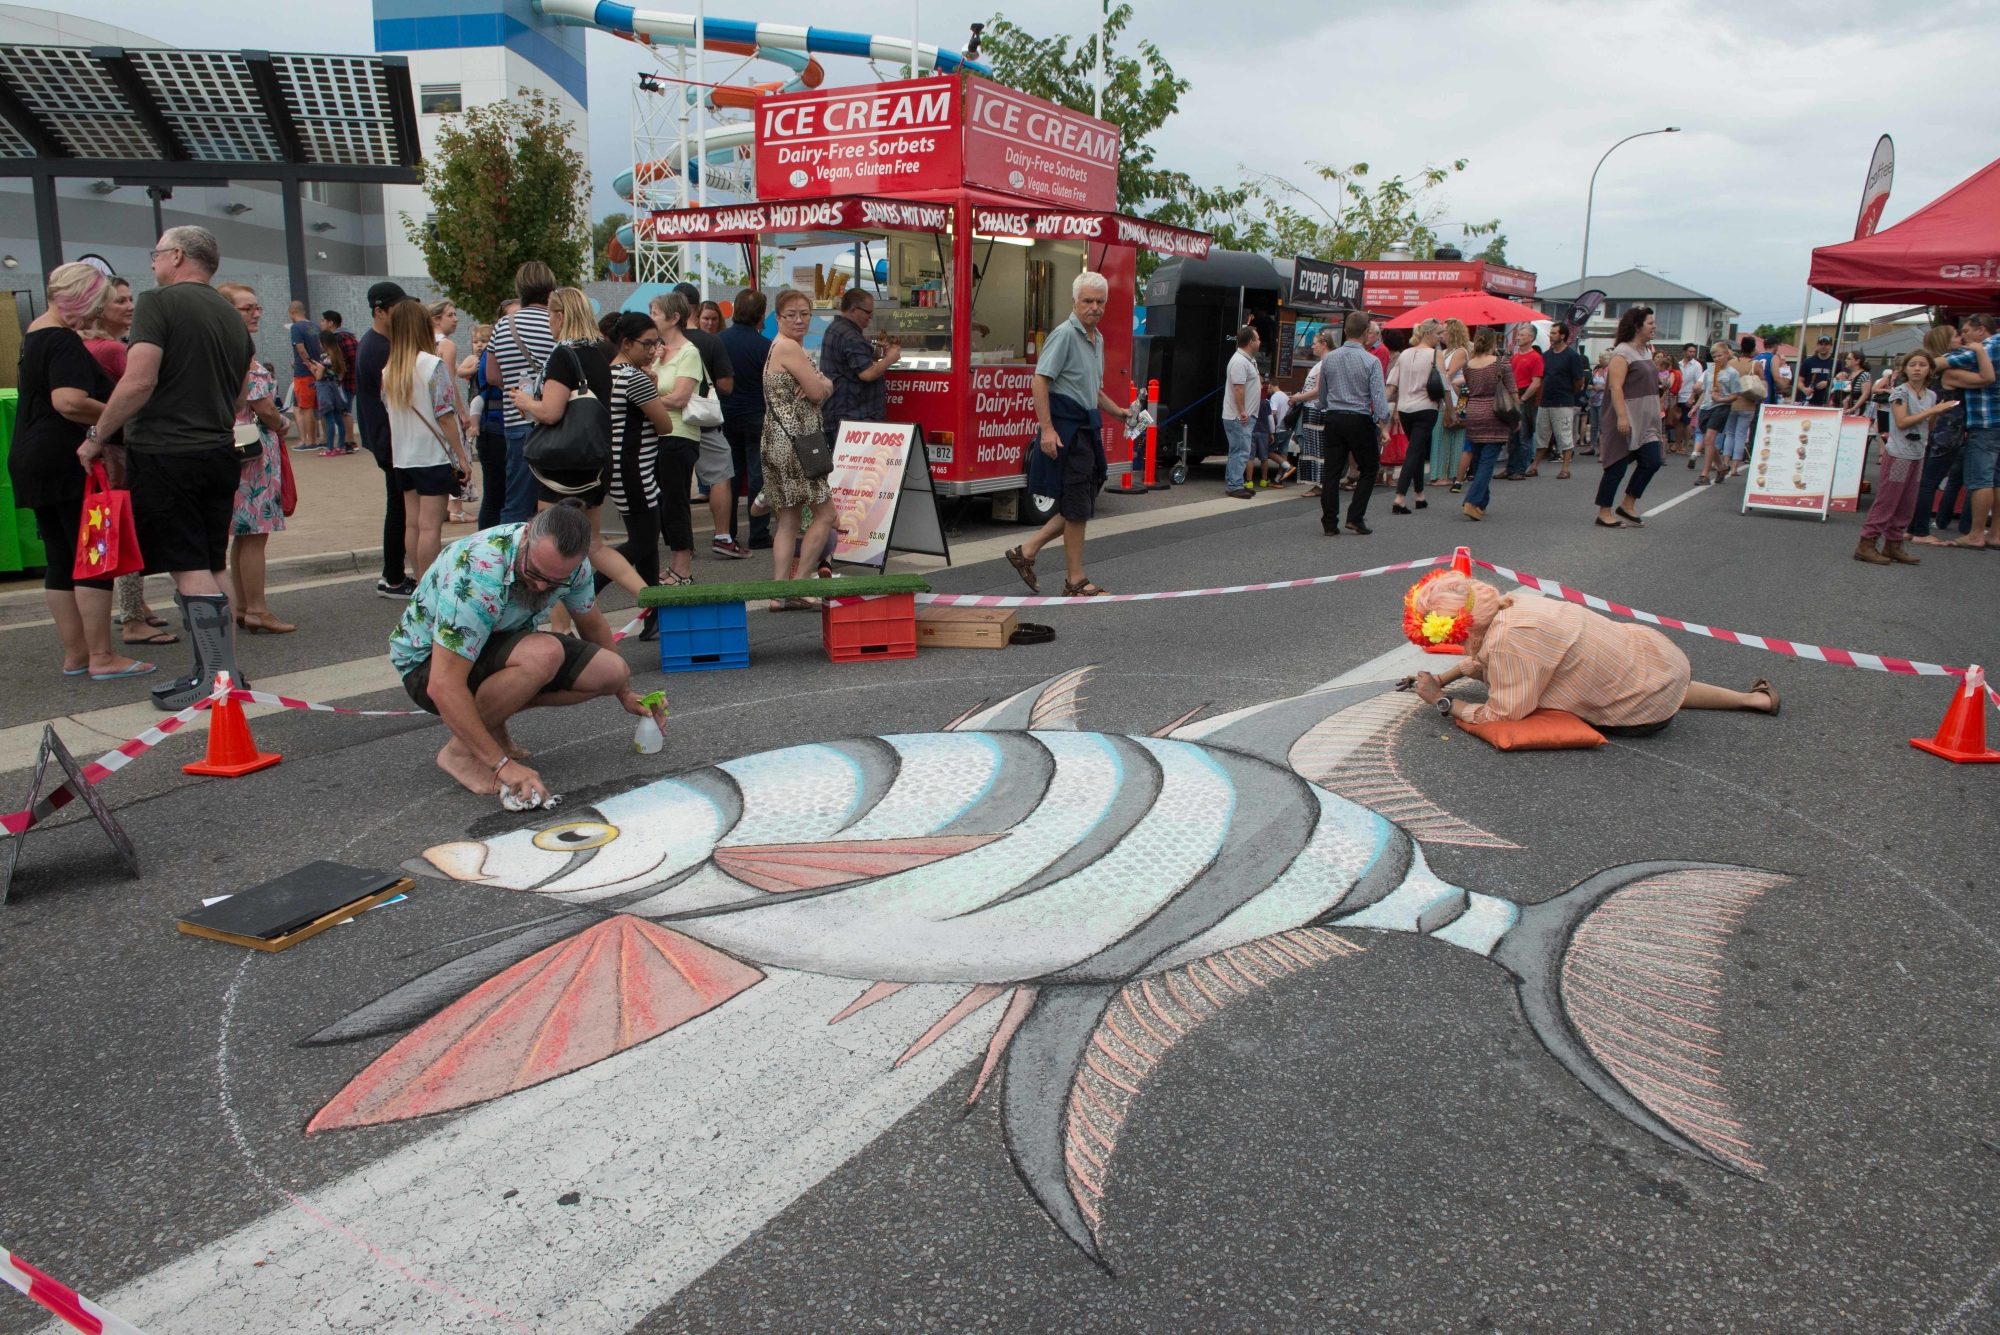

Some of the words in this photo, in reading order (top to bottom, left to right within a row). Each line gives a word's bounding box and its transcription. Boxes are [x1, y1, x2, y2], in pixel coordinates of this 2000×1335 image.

[764, 105, 816, 138] ICE
[823, 92, 951, 131] CREAM
[972, 94, 1022, 134] ICE
[1026, 113, 1116, 163] CREAM
[778, 143, 864, 165] Dairy-Free
[868, 137, 935, 156] Sorbets
[816, 165, 853, 182] Vegan,
[855, 161, 893, 177] Gluten
[894, 159, 920, 173] Free
[1005, 146, 1054, 174] Dairy-Free
[1055, 161, 1088, 183] Sorbets
[1051, 182, 1073, 199] Gluten
[1073, 187, 1087, 202] Free
[656, 213, 709, 235] KRANSKI
[714, 209, 766, 232] SHAKES
[770, 205, 797, 228] HOT
[800, 201, 843, 226] DOGS
[862, 201, 900, 225] SHAKES
[901, 205, 920, 225] HOT
[920, 208, 946, 229] DOGS
[978, 212, 1028, 235] SHAKES
[1035, 215, 1062, 234] HOT
[1063, 216, 1104, 237] DOGS
[1118, 220, 1149, 244] KRANSKI
[1149, 228, 1175, 252] SHAKES
[1176, 234, 1188, 252] HOT
[1188, 237, 1207, 256] DOGS
[1940, 258, 2000, 279] caf
[1299, 270, 1329, 299] crepe
[1342, 267, 1359, 299] bar
[885, 380, 911, 391] RESH
[912, 380, 949, 393] FRUITS
[972, 369, 991, 389] Ice
[994, 369, 1033, 389] Cream
[886, 393, 904, 404] ree
[976, 393, 1034, 417] Dairy-Fre
[845, 430, 870, 444] HOT
[872, 431, 904, 447] DOGS
[978, 418, 1024, 438] Hahndorf
[849, 455, 863, 463] HOT
[863, 456, 877, 464] DOG
[936, 447, 951, 459] 872
[977, 445, 995, 462] Hot
[996, 445, 1021, 464] Dogs
[937, 466, 948, 474] 665
[842, 488, 860, 497] CHILLI
[861, 490, 874, 498] DOG
